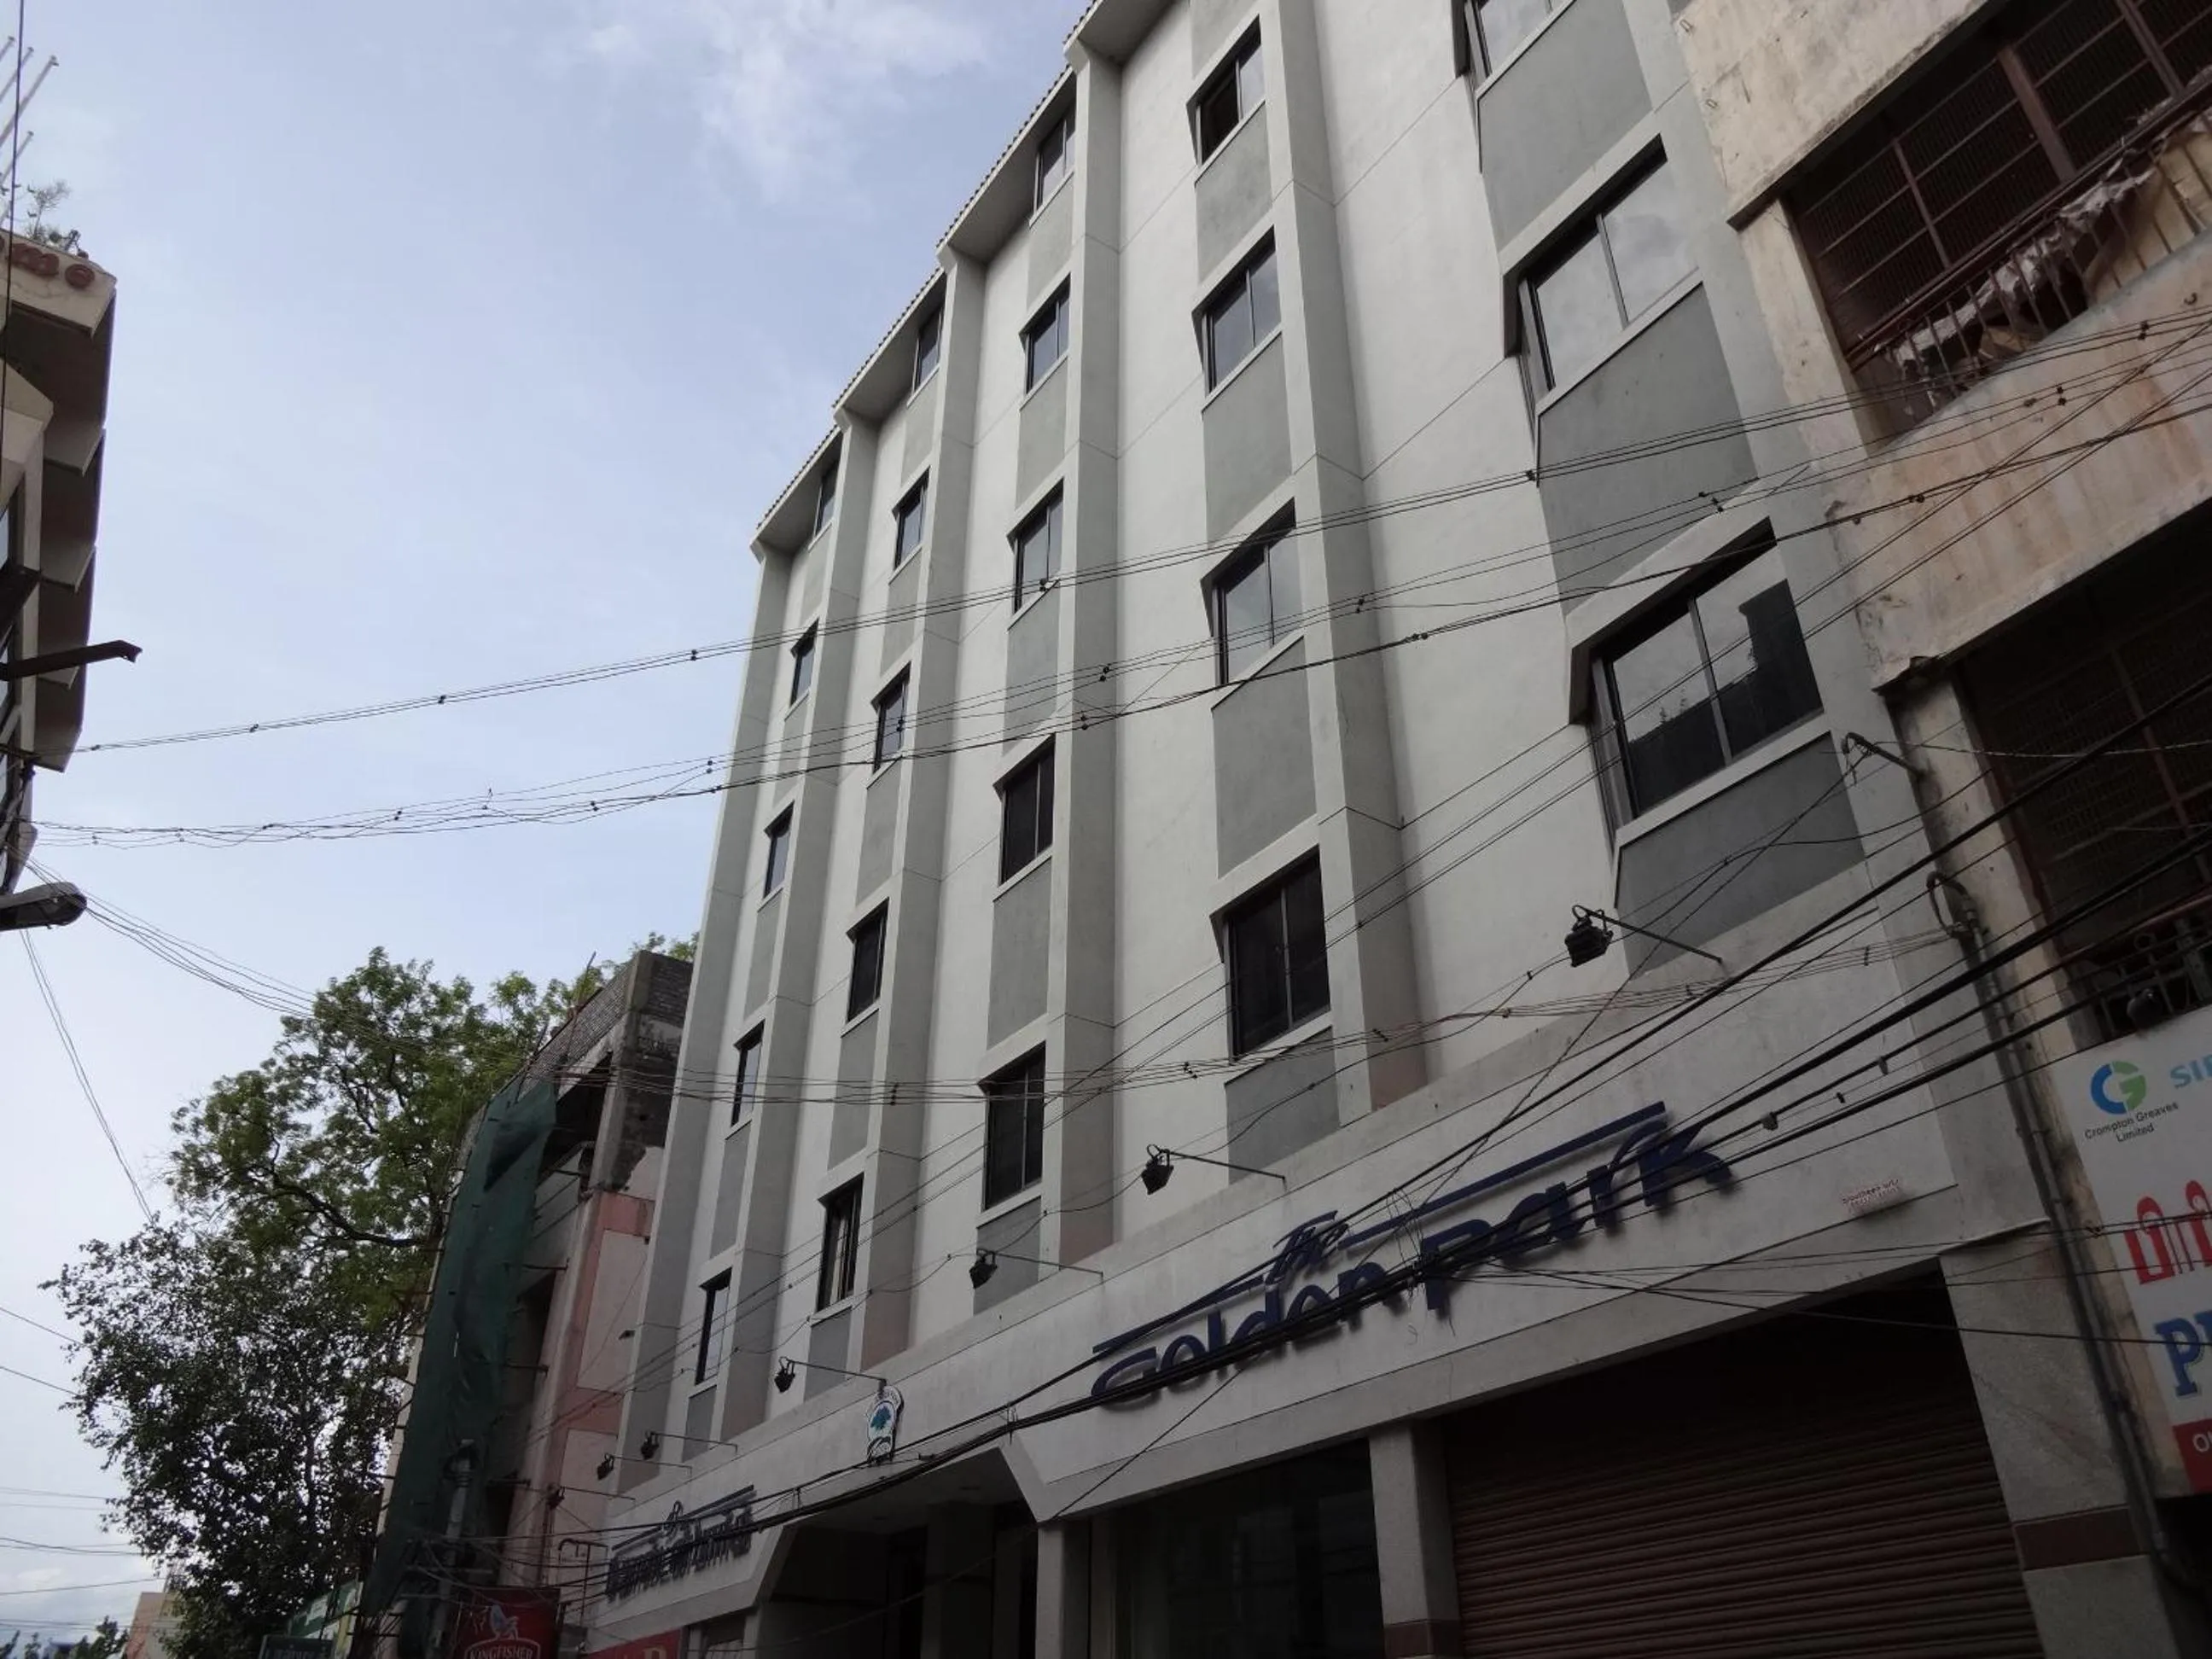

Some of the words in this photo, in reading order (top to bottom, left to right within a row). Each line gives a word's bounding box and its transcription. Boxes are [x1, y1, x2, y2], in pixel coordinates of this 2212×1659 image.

[2084, 1117, 2135, 1140] Crompton
[2135, 1102, 2180, 1122] Greaves
[2116, 1123, 2155, 1142] Limited
